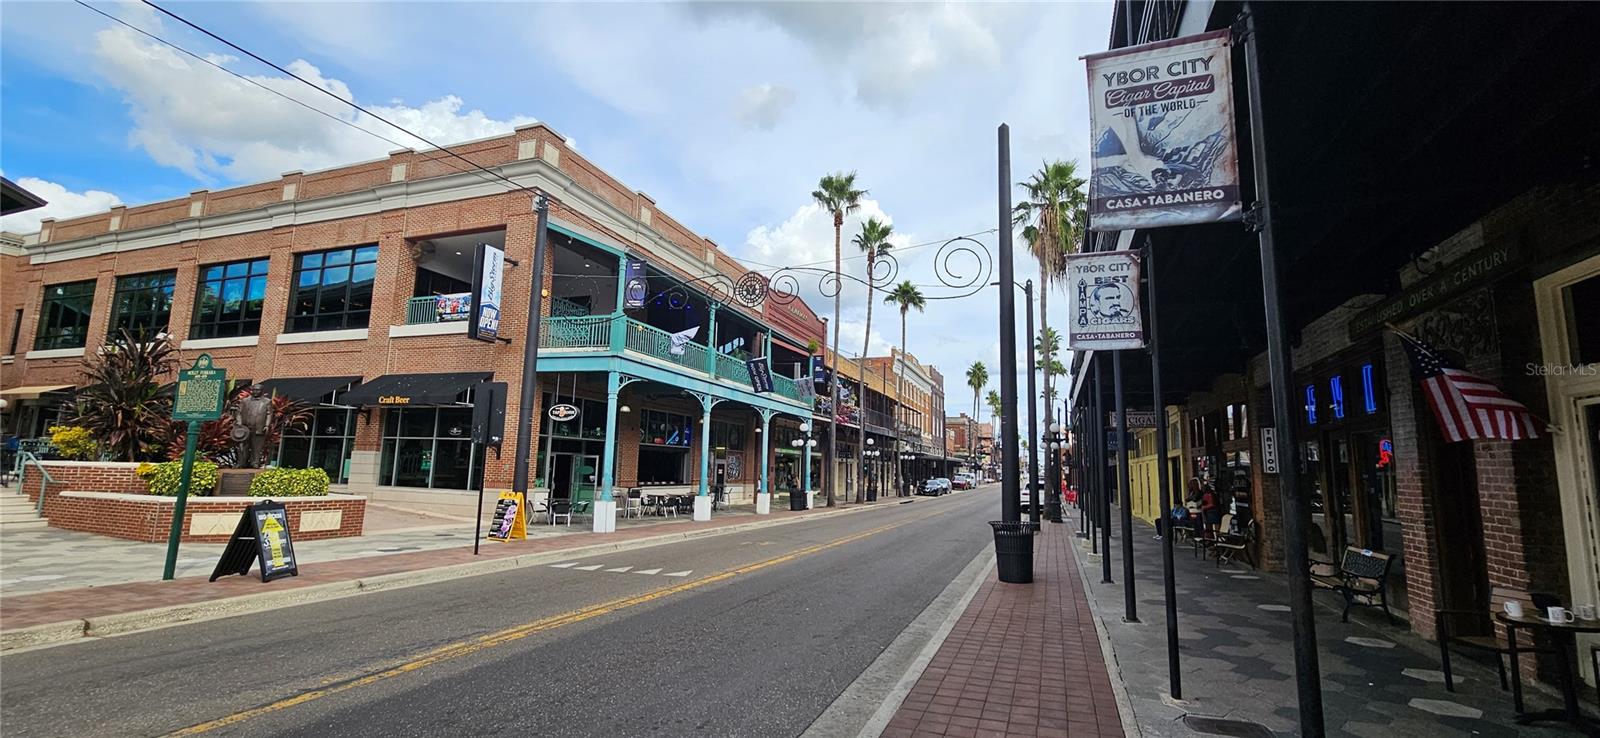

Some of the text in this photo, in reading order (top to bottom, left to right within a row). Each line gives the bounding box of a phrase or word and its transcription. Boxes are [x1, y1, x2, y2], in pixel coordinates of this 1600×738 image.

[1103, 55, 1214, 87] YBOR CITY
[1106, 79, 1212, 107] Cigar Capital
[1124, 99, 1196, 118] OF THE WORLD
[1075, 262, 1132, 274] YBOR CITY
[1094, 275, 1129, 285] BEST
[1408, 287, 1434, 308] OVER
[1439, 281, 1448, 294] A
[1453, 249, 1509, 285] CENTURY
[483, 307, 498, 319] NOW
[1090, 316, 1136, 325] CIGARS
[378, 396, 410, 404] Craft Beer
[1265, 429, 1275, 472] TATTOO
